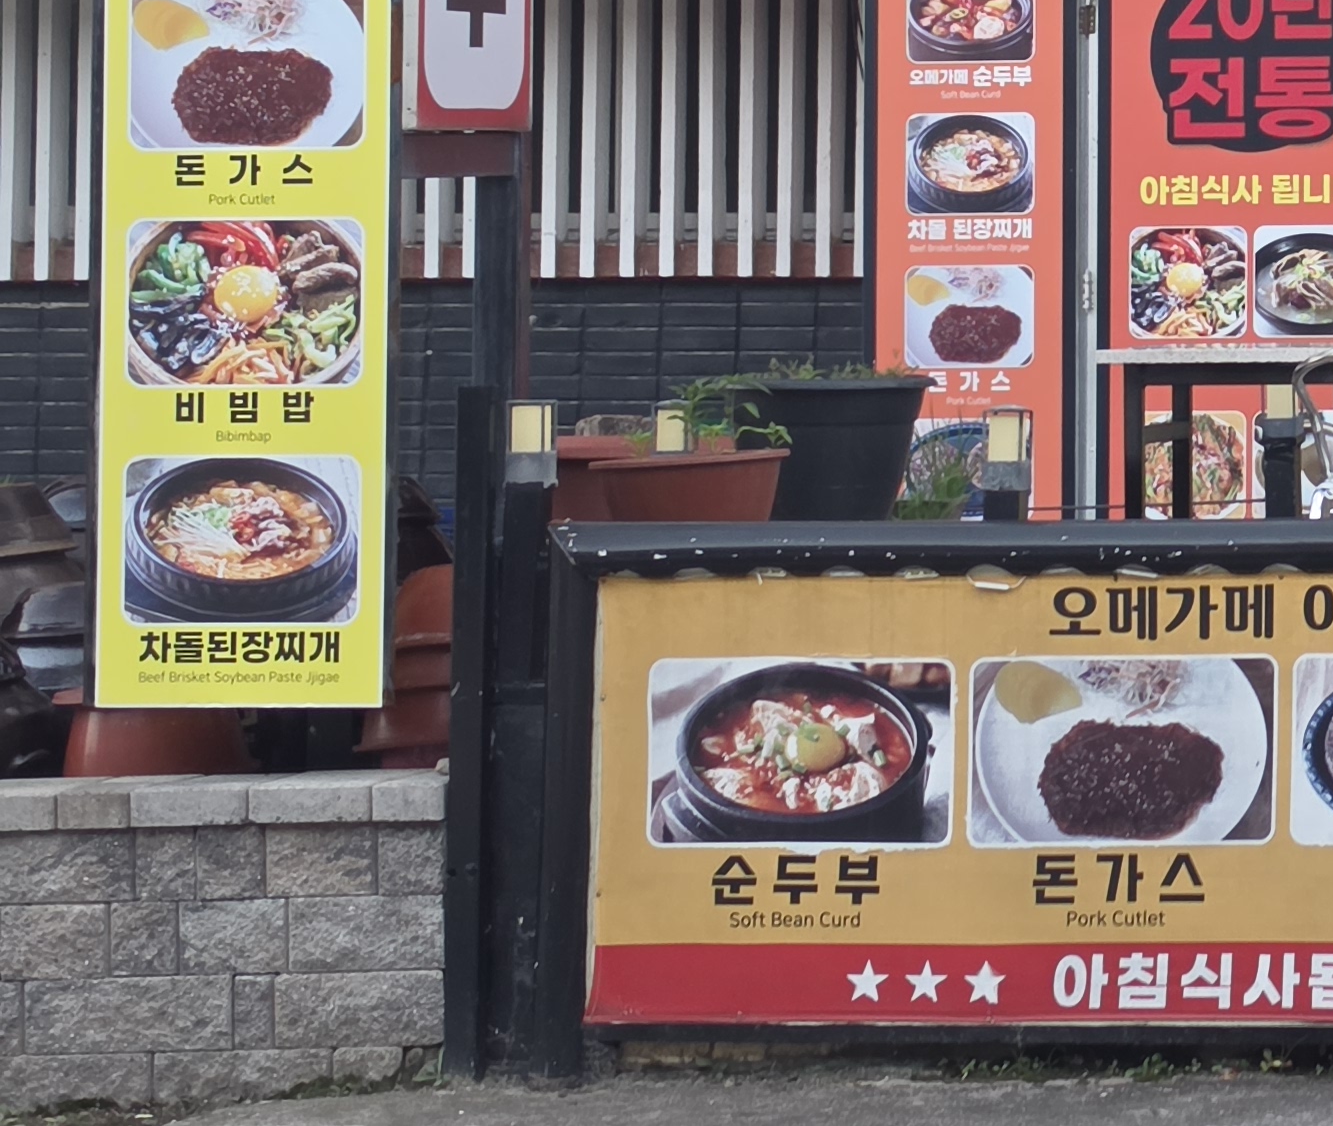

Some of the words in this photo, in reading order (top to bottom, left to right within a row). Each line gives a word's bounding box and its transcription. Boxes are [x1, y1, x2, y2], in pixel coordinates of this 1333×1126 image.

[972, 65, 1033, 87] 순두부
[208, 193, 237, 206] Pork
[239, 192, 276, 206] Cutlet
[1139, 174, 1263, 206] 아침식사
[952, 217, 1033, 240] 된장찌개
[215, 429, 272, 445] Bibimbap
[1048, 583, 1275, 641] 오메가메
[138, 630, 340, 664] 차돌된장찌개
[138, 670, 166, 684] Beef
[168, 670, 211, 684] Brisket
[213, 670, 266, 686] Soybean
[268, 670, 303, 683] Paste
[305, 671, 341, 686] Jjigae
[711, 854, 881, 906] 순두부
[1032, 852, 1205, 905] 돈가스
[729, 911, 766, 929] Soft
[771, 911, 815, 928] Bean
[819, 911, 861, 928] Curd
[1066, 910, 1107, 928] Pork
[1112, 909, 1165, 927] Cutlet
